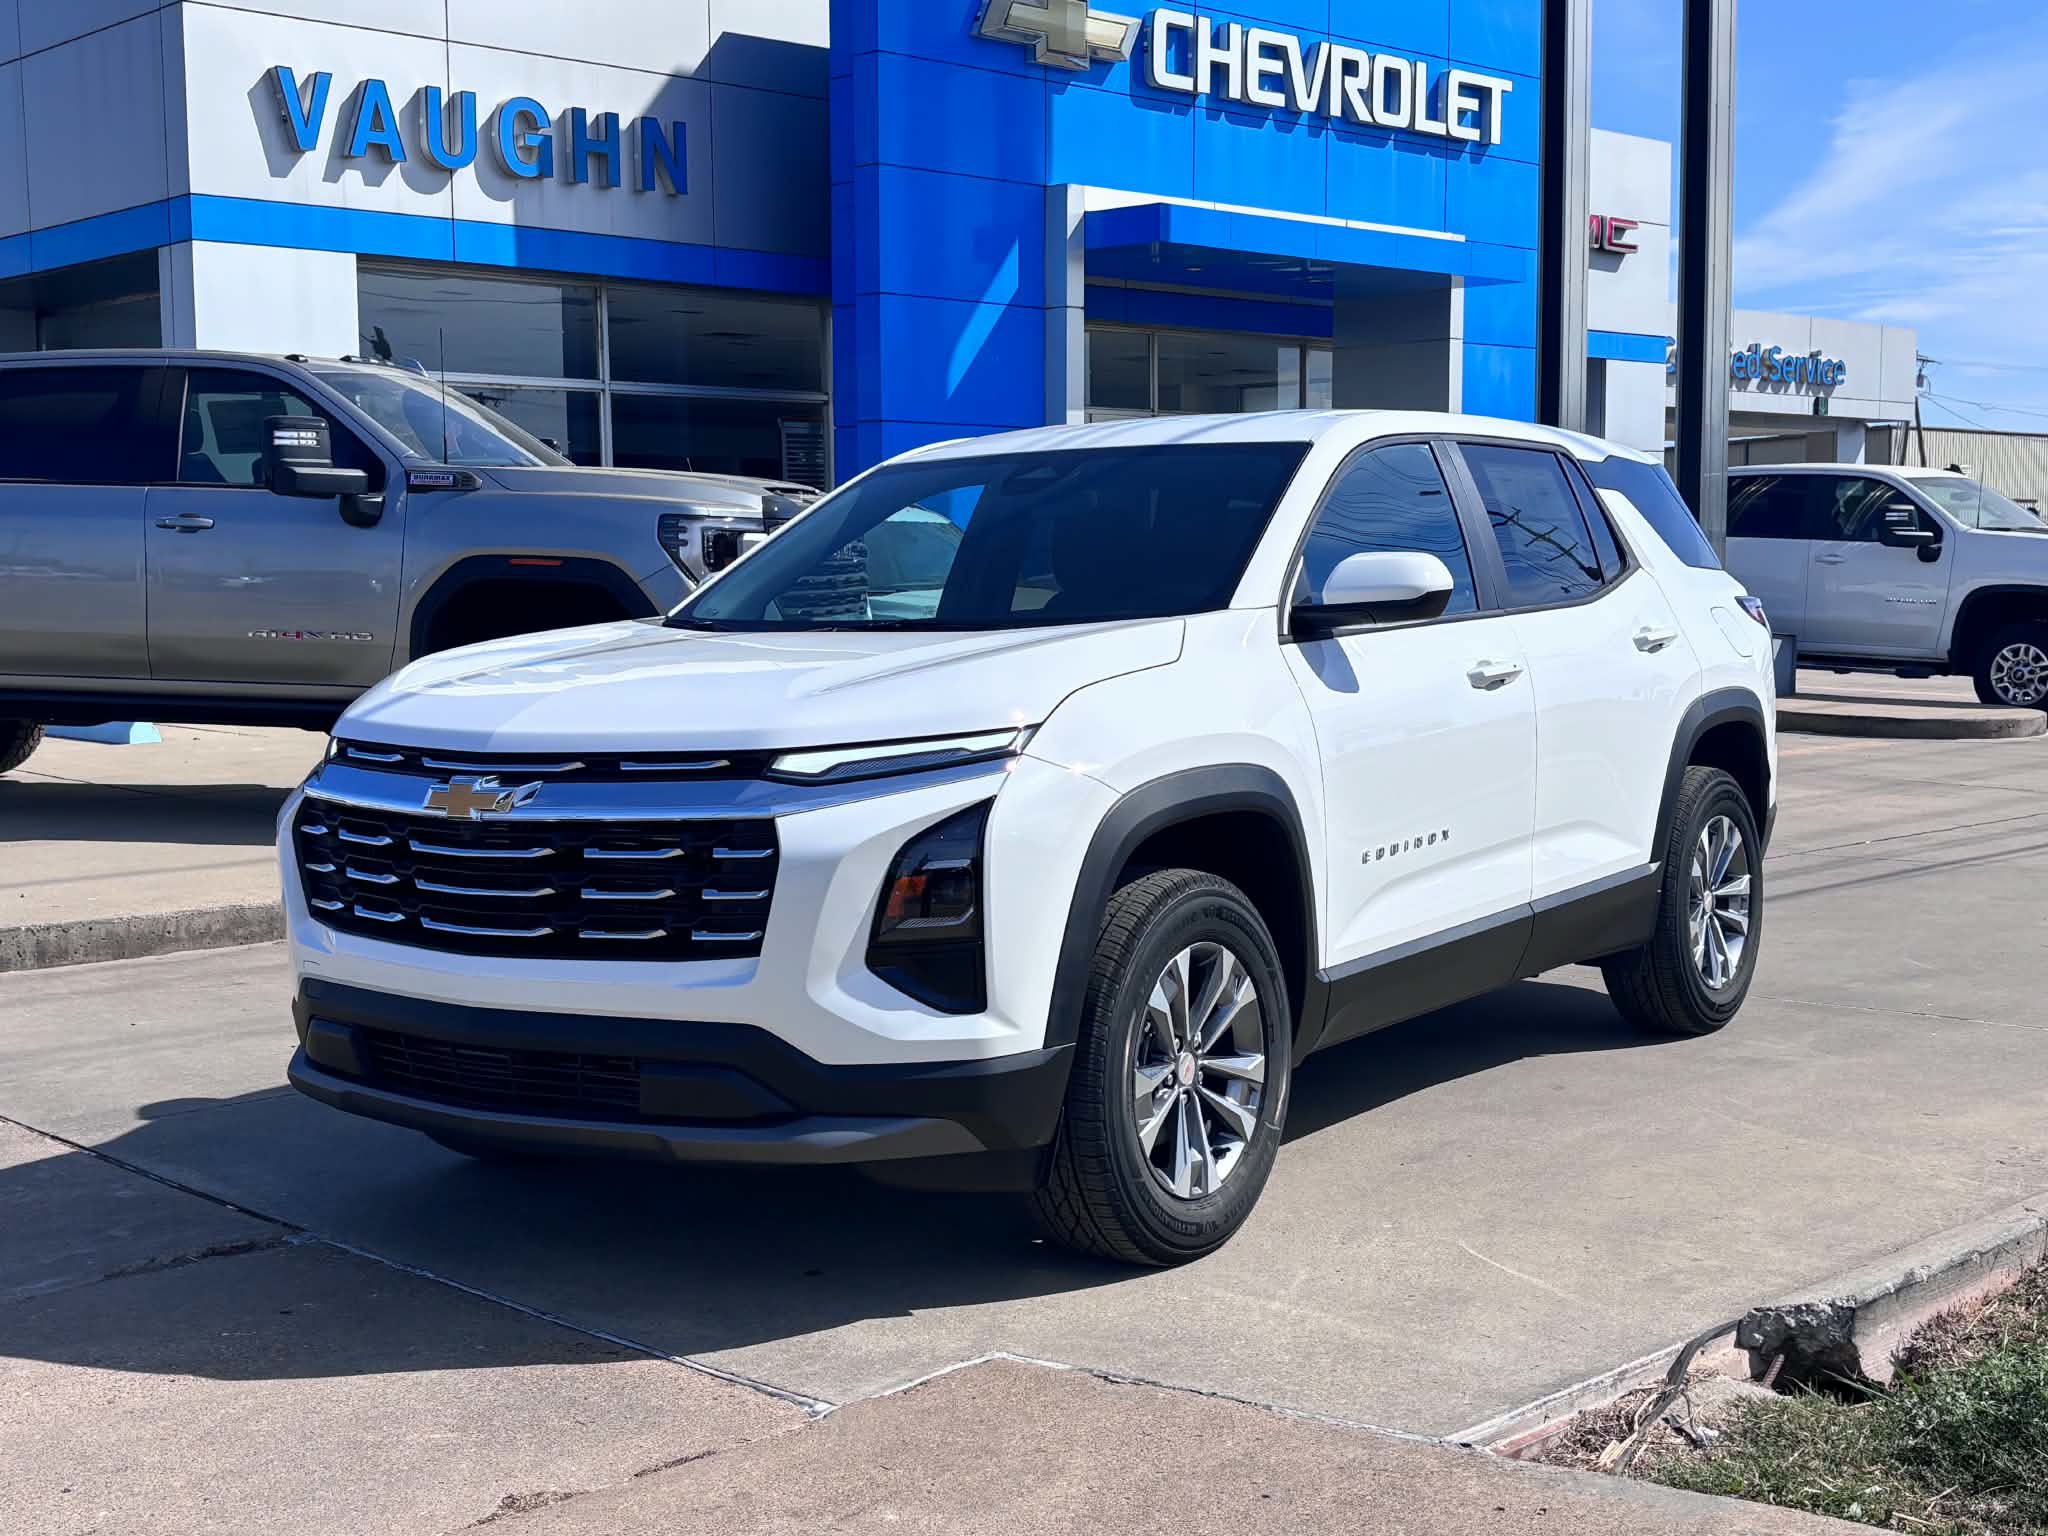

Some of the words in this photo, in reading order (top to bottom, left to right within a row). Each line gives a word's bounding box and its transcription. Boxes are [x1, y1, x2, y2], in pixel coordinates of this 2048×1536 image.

[1150, 8, 1513, 145] CHEVROLET
[274, 65, 689, 195] VAUGHN
[1768, 344, 1847, 386] Service
[1361, 829, 1449, 864] EQUINOX
